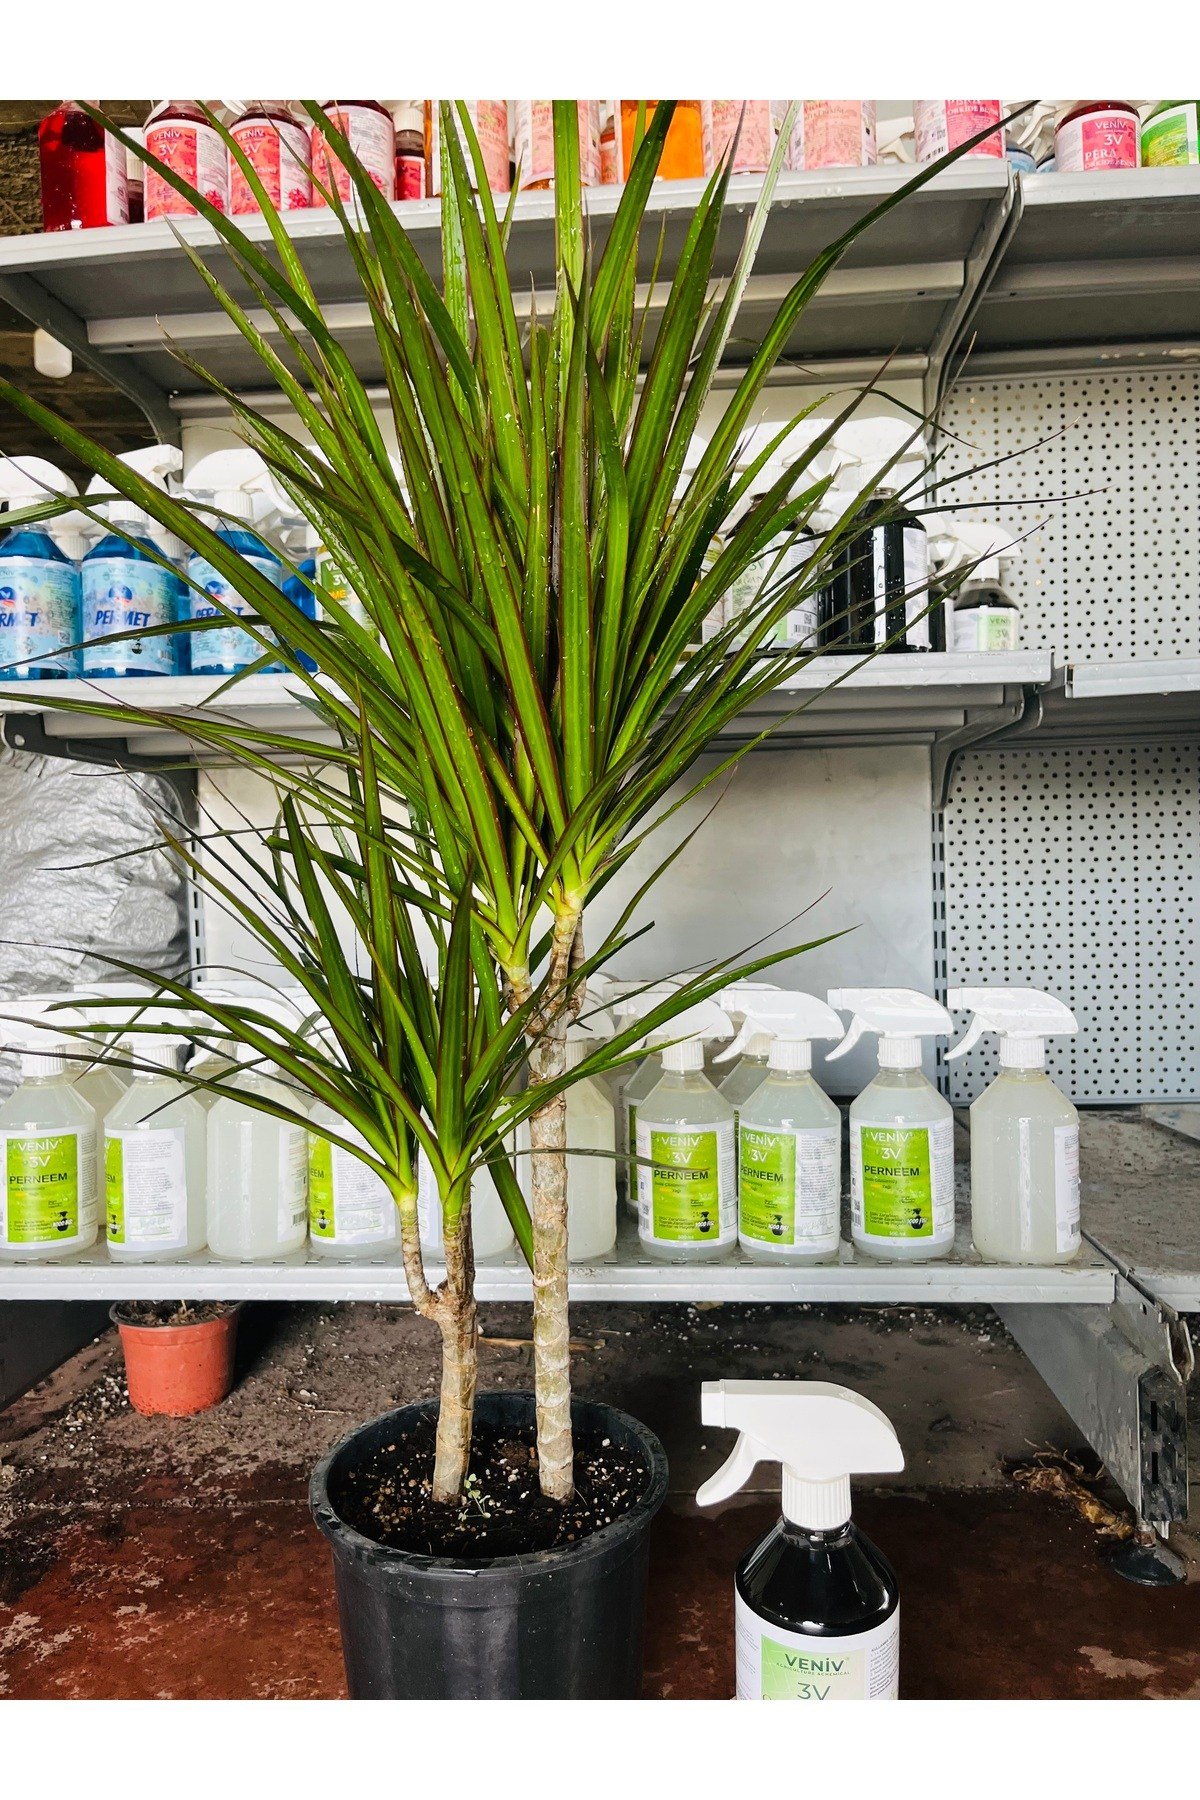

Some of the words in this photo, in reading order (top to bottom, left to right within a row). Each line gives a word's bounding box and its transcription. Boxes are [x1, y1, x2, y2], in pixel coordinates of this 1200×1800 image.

[1104, 133, 1124, 146] 3V
[159, 143, 177, 156] 3V
[243, 142, 262, 156] 3V
[1085, 149, 1117, 161] PERA
[662, 1134, 701, 1147] VENİV
[745, 1132, 777, 1147] VENİV
[871, 1131, 909, 1143] VENİV
[17, 1139, 59, 1153] VENİV
[672, 1152, 692, 1164] 3V
[751, 1149, 768, 1162] 3V
[881, 1147, 901, 1160] 3V
[29, 1155, 51, 1168] 3V
[653, 1169, 709, 1181] PERNEEM
[864, 1165, 920, 1177] PERNEEM
[9, 1172, 68, 1185] PERNEEM
[784, 1653, 844, 1672] VENİV
[797, 1682, 831, 1700] 3V
